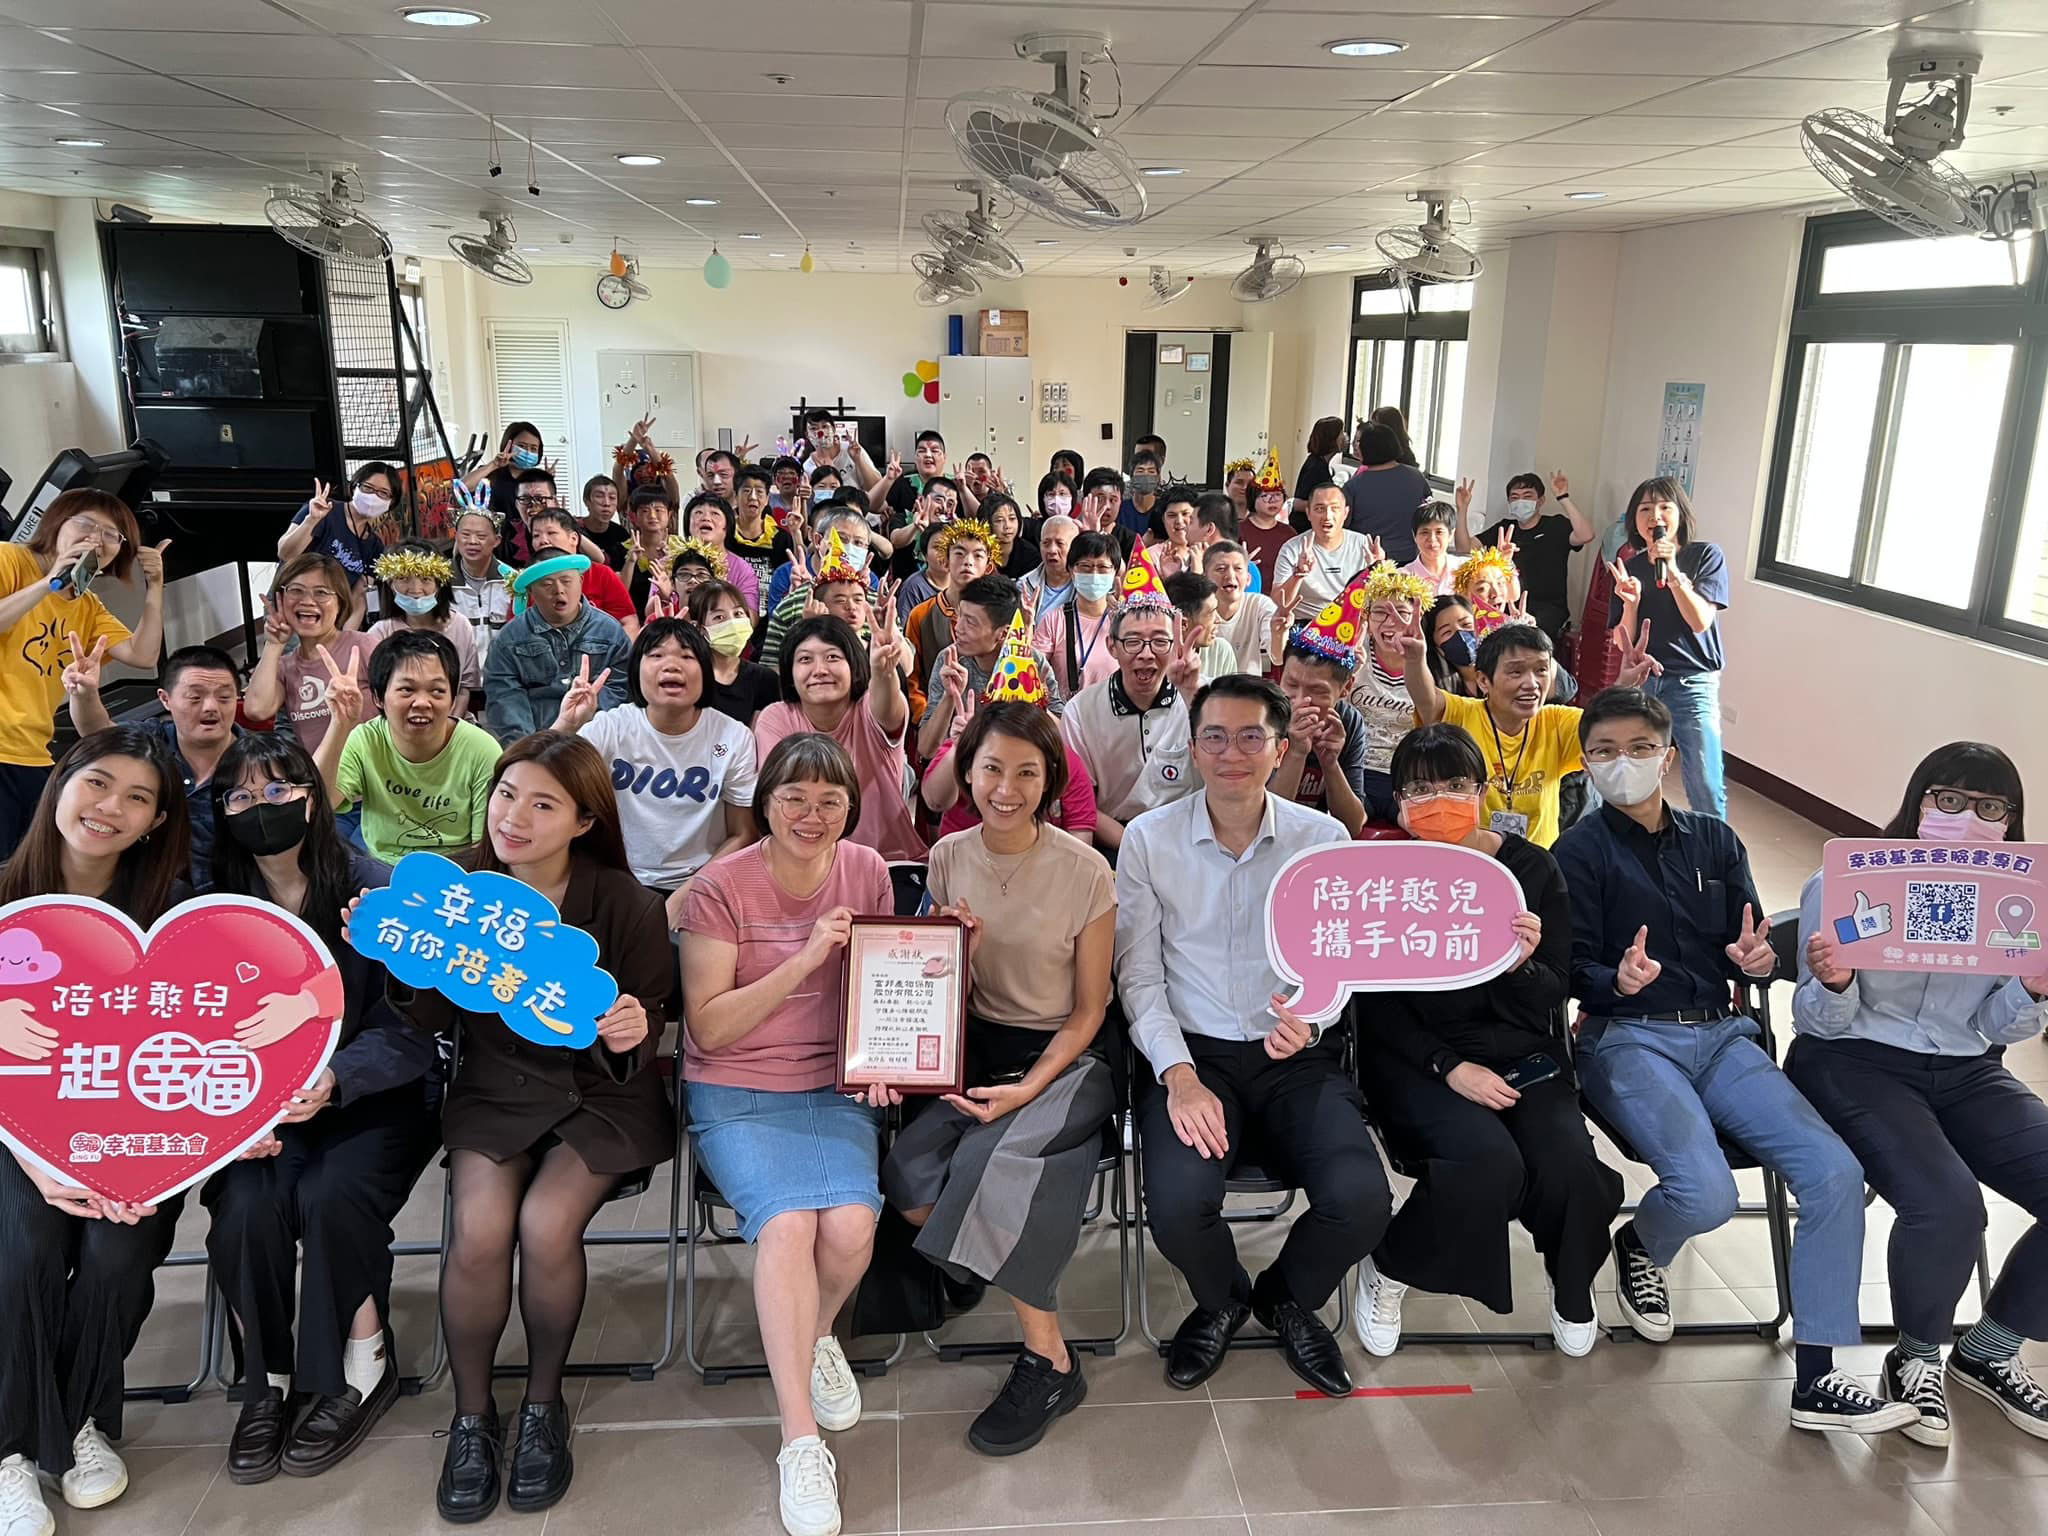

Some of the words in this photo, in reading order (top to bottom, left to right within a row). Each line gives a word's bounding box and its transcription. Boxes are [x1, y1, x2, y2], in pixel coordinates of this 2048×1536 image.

[1847, 847, 2034, 874] 幸福基金會臉書專頁
[1311, 875, 1485, 916] 陪伴憨兒
[432, 882, 531, 952] 幸福
[1310, 918, 1481, 962] 攜手向前
[1905, 951, 1979, 967] 幸福基金會
[376, 915, 574, 1035] 有你陪著走
[51, 981, 229, 1018] 陪伴憨兒
[104, 1132, 208, 1156] 幸福基金會
